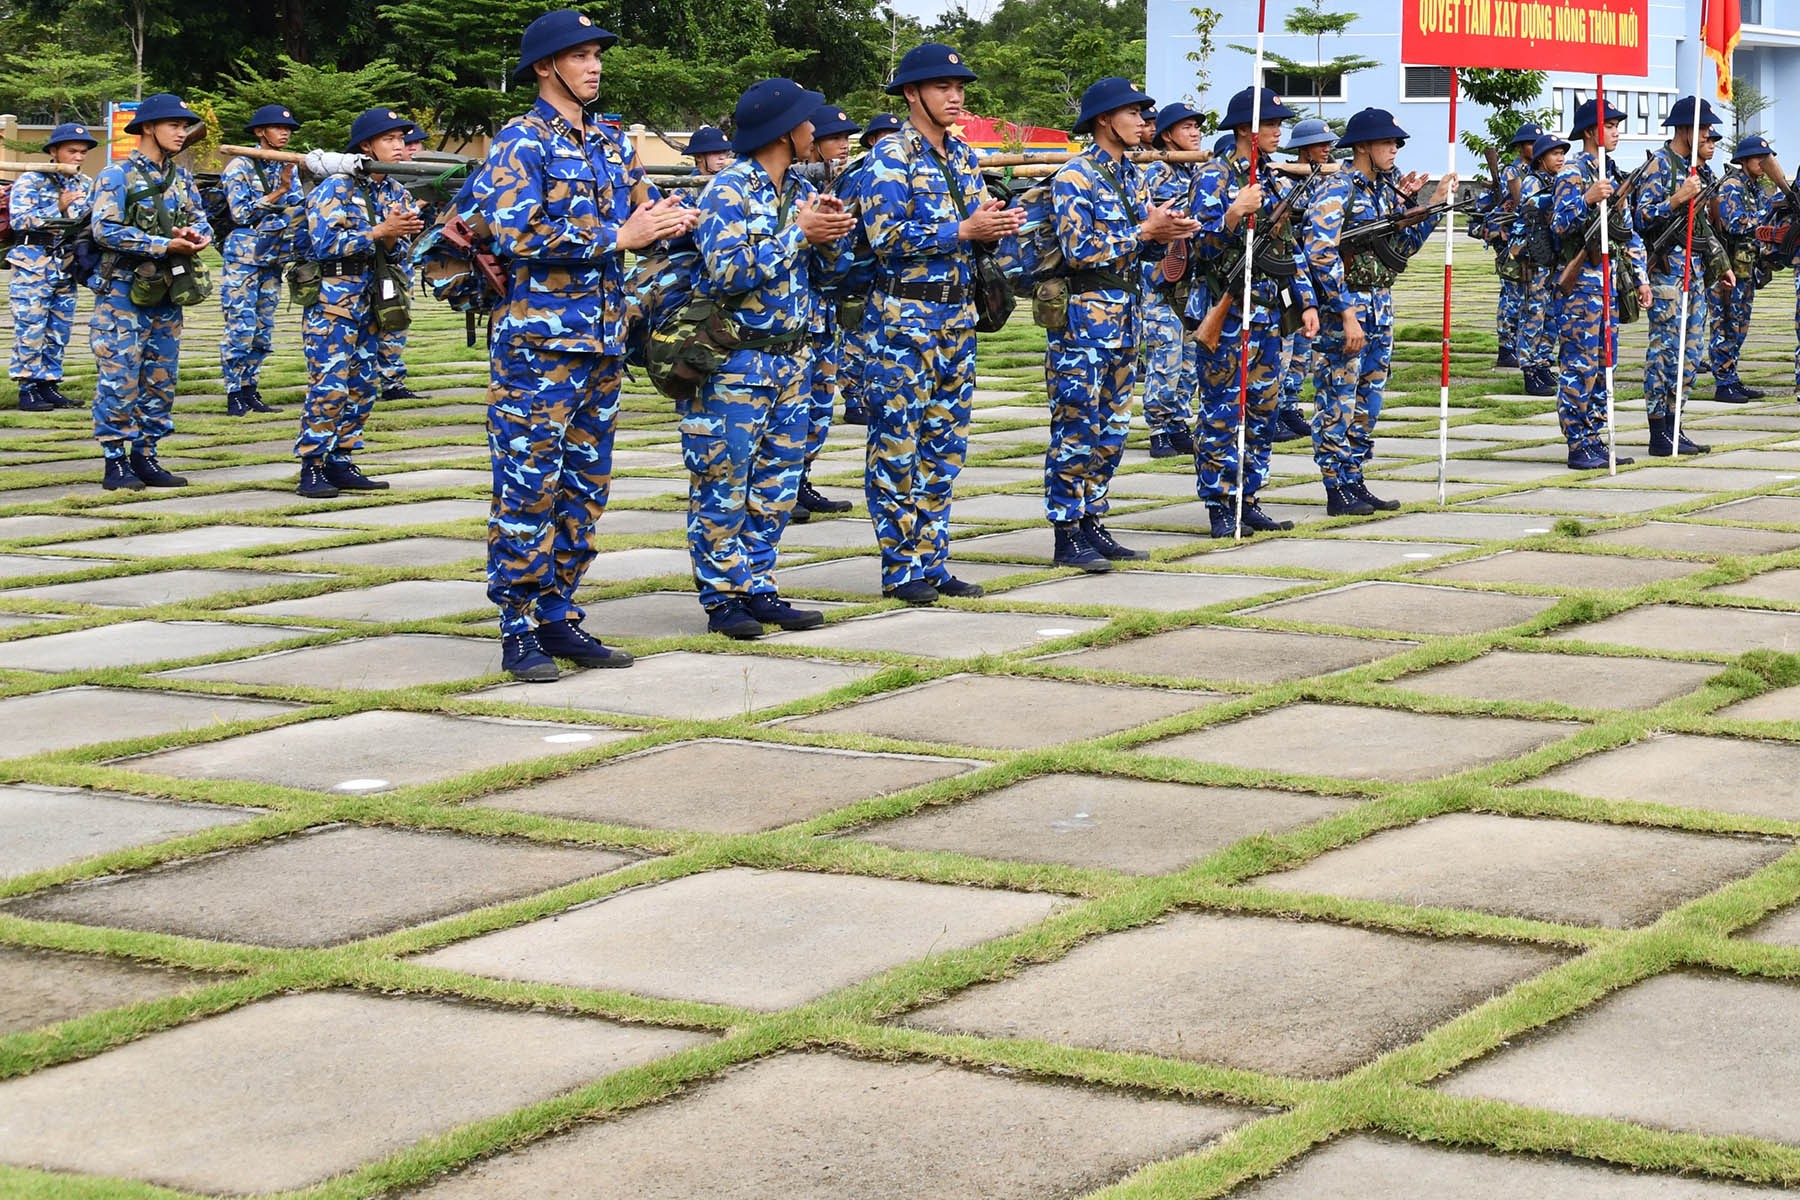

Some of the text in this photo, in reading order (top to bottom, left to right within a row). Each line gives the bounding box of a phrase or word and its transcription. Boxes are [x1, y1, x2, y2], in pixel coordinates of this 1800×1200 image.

[1520, 0, 1552, 48] DỰNG
[1555, 0, 1586, 43] NÔNG
[1588, 3, 1616, 46] THÔN
[1619, 7, 1638, 48] MỚI
